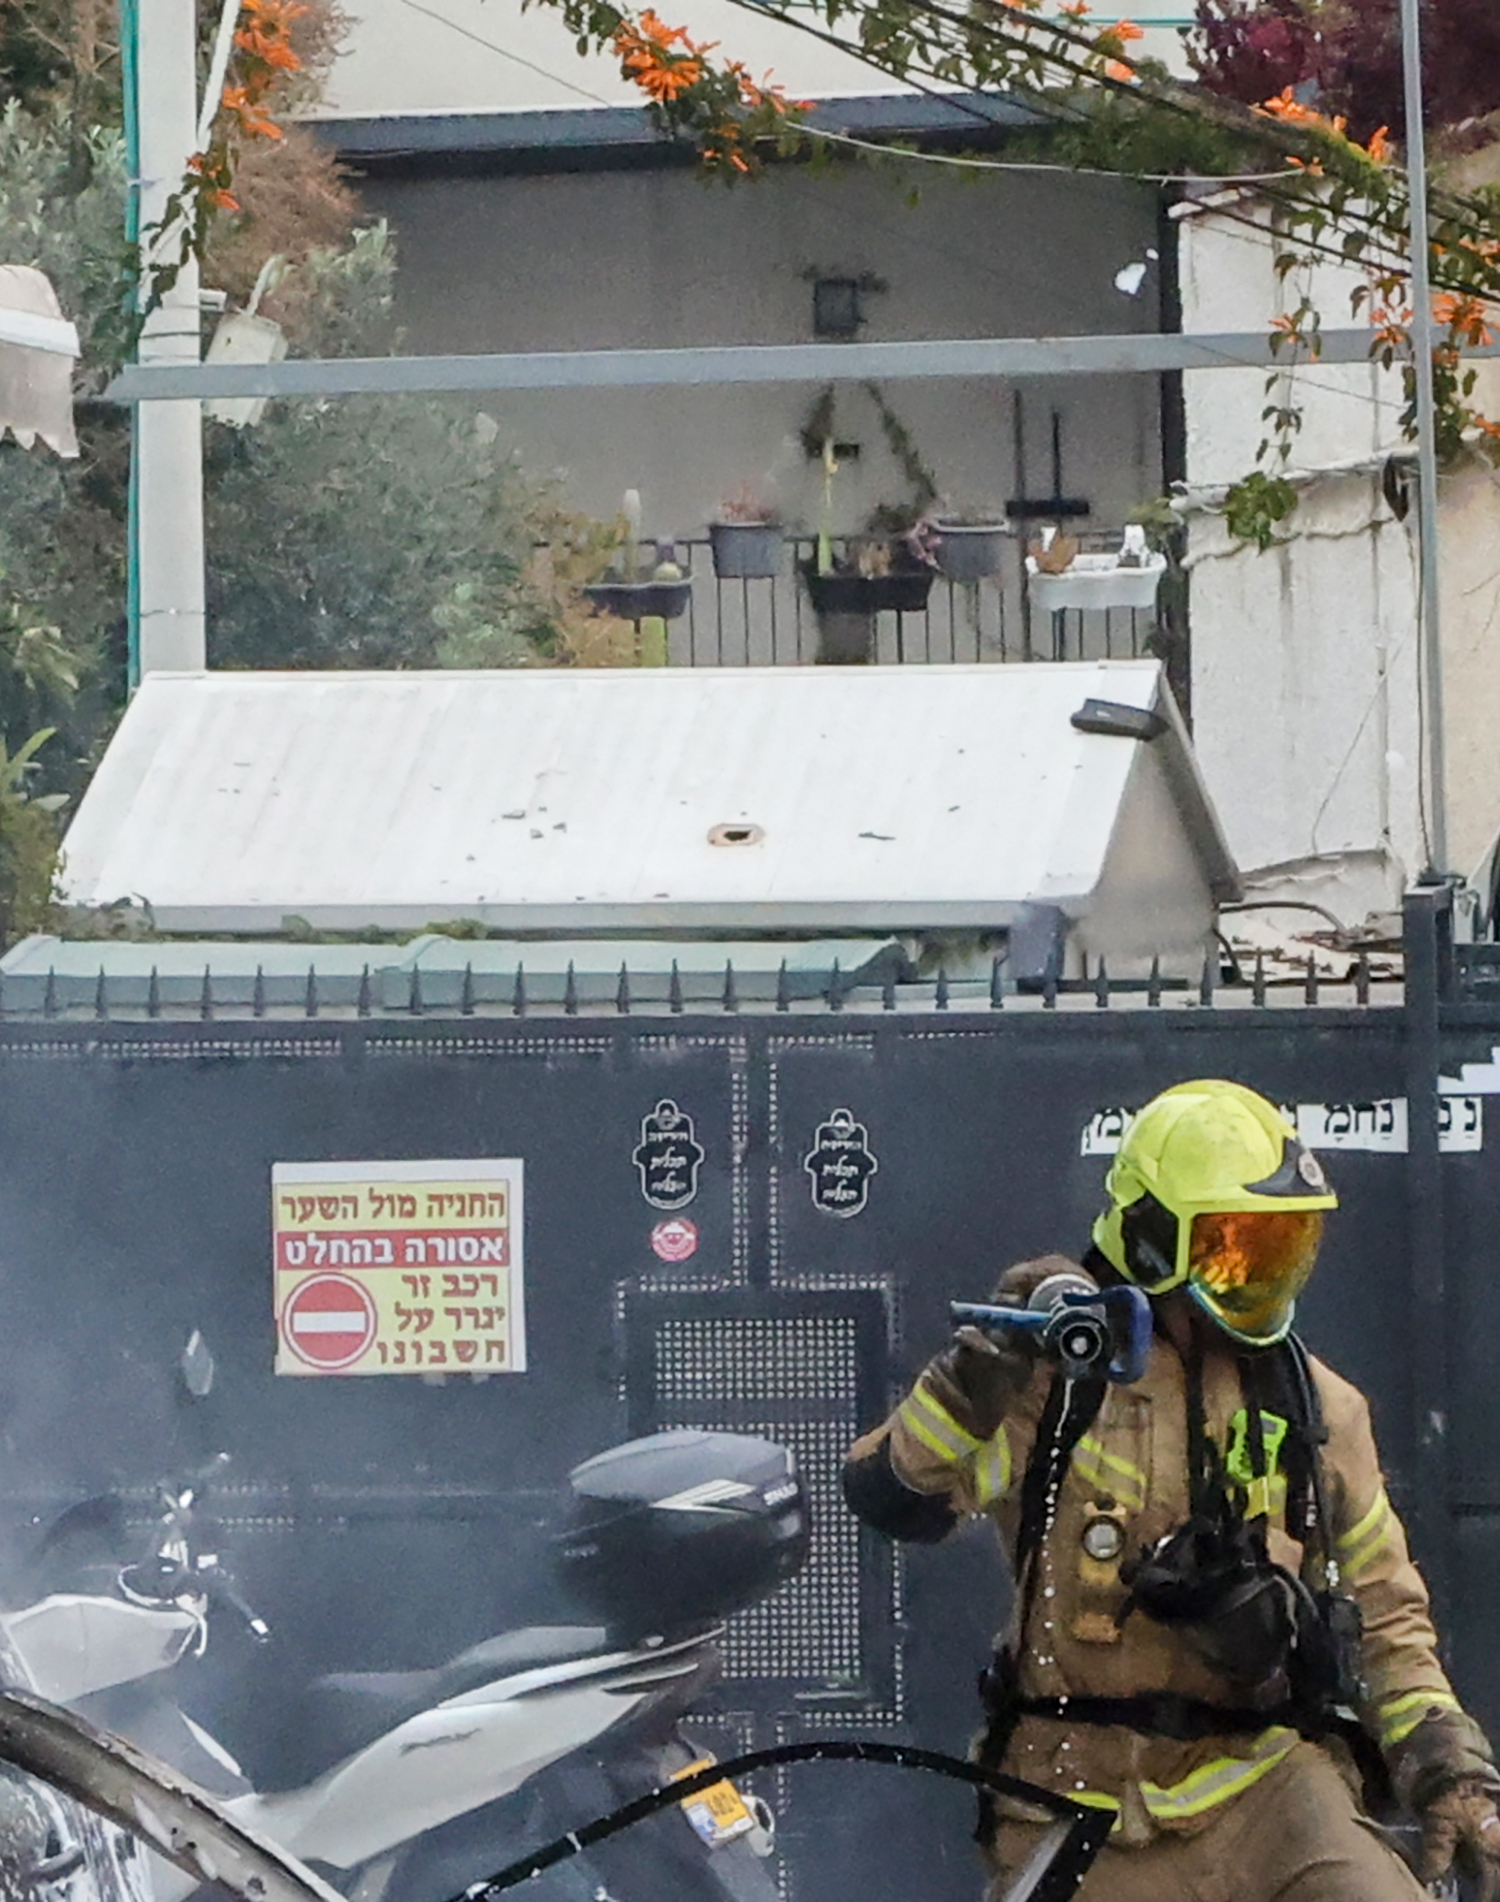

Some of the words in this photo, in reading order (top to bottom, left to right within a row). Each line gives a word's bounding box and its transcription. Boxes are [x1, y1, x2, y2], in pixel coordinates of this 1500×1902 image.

[280, 1195, 358, 1223] השער
[369, 1188, 417, 1218] מול
[427, 1192, 505, 1218] החניה
[285, 1232, 394, 1265] בהחלט
[405, 1236, 504, 1262] אסורה
[401, 1274, 431, 1299] זר
[442, 1273, 498, 1298] רכב
[394, 1301, 434, 1333] על
[444, 1304, 505, 1331] יגרר
[376, 1338, 505, 1364] חשבונו
